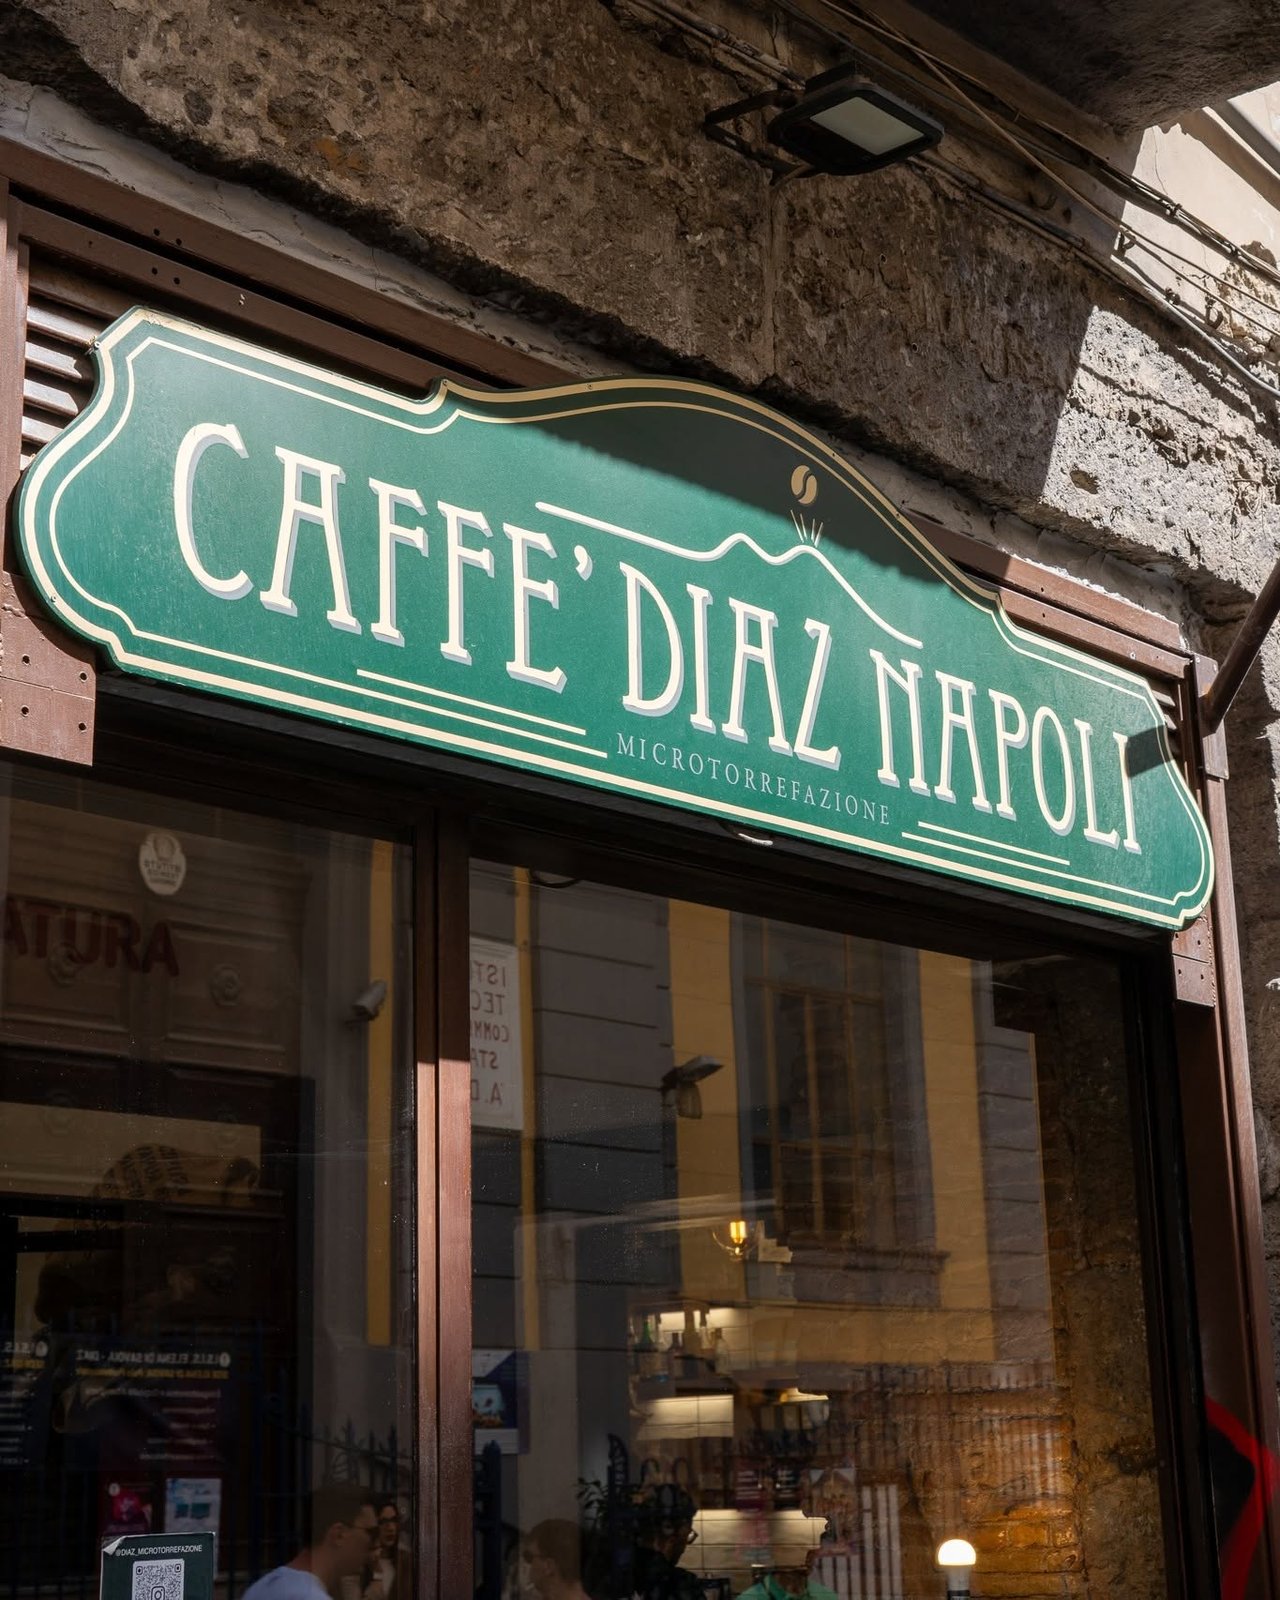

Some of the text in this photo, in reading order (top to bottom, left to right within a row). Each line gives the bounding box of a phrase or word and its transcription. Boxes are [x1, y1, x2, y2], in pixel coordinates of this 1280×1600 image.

[616, 732, 890, 826] MICROTORREFAZIONE
[618, 560, 842, 771] DIAZ
[869, 648, 1142, 854] NAPOLI
